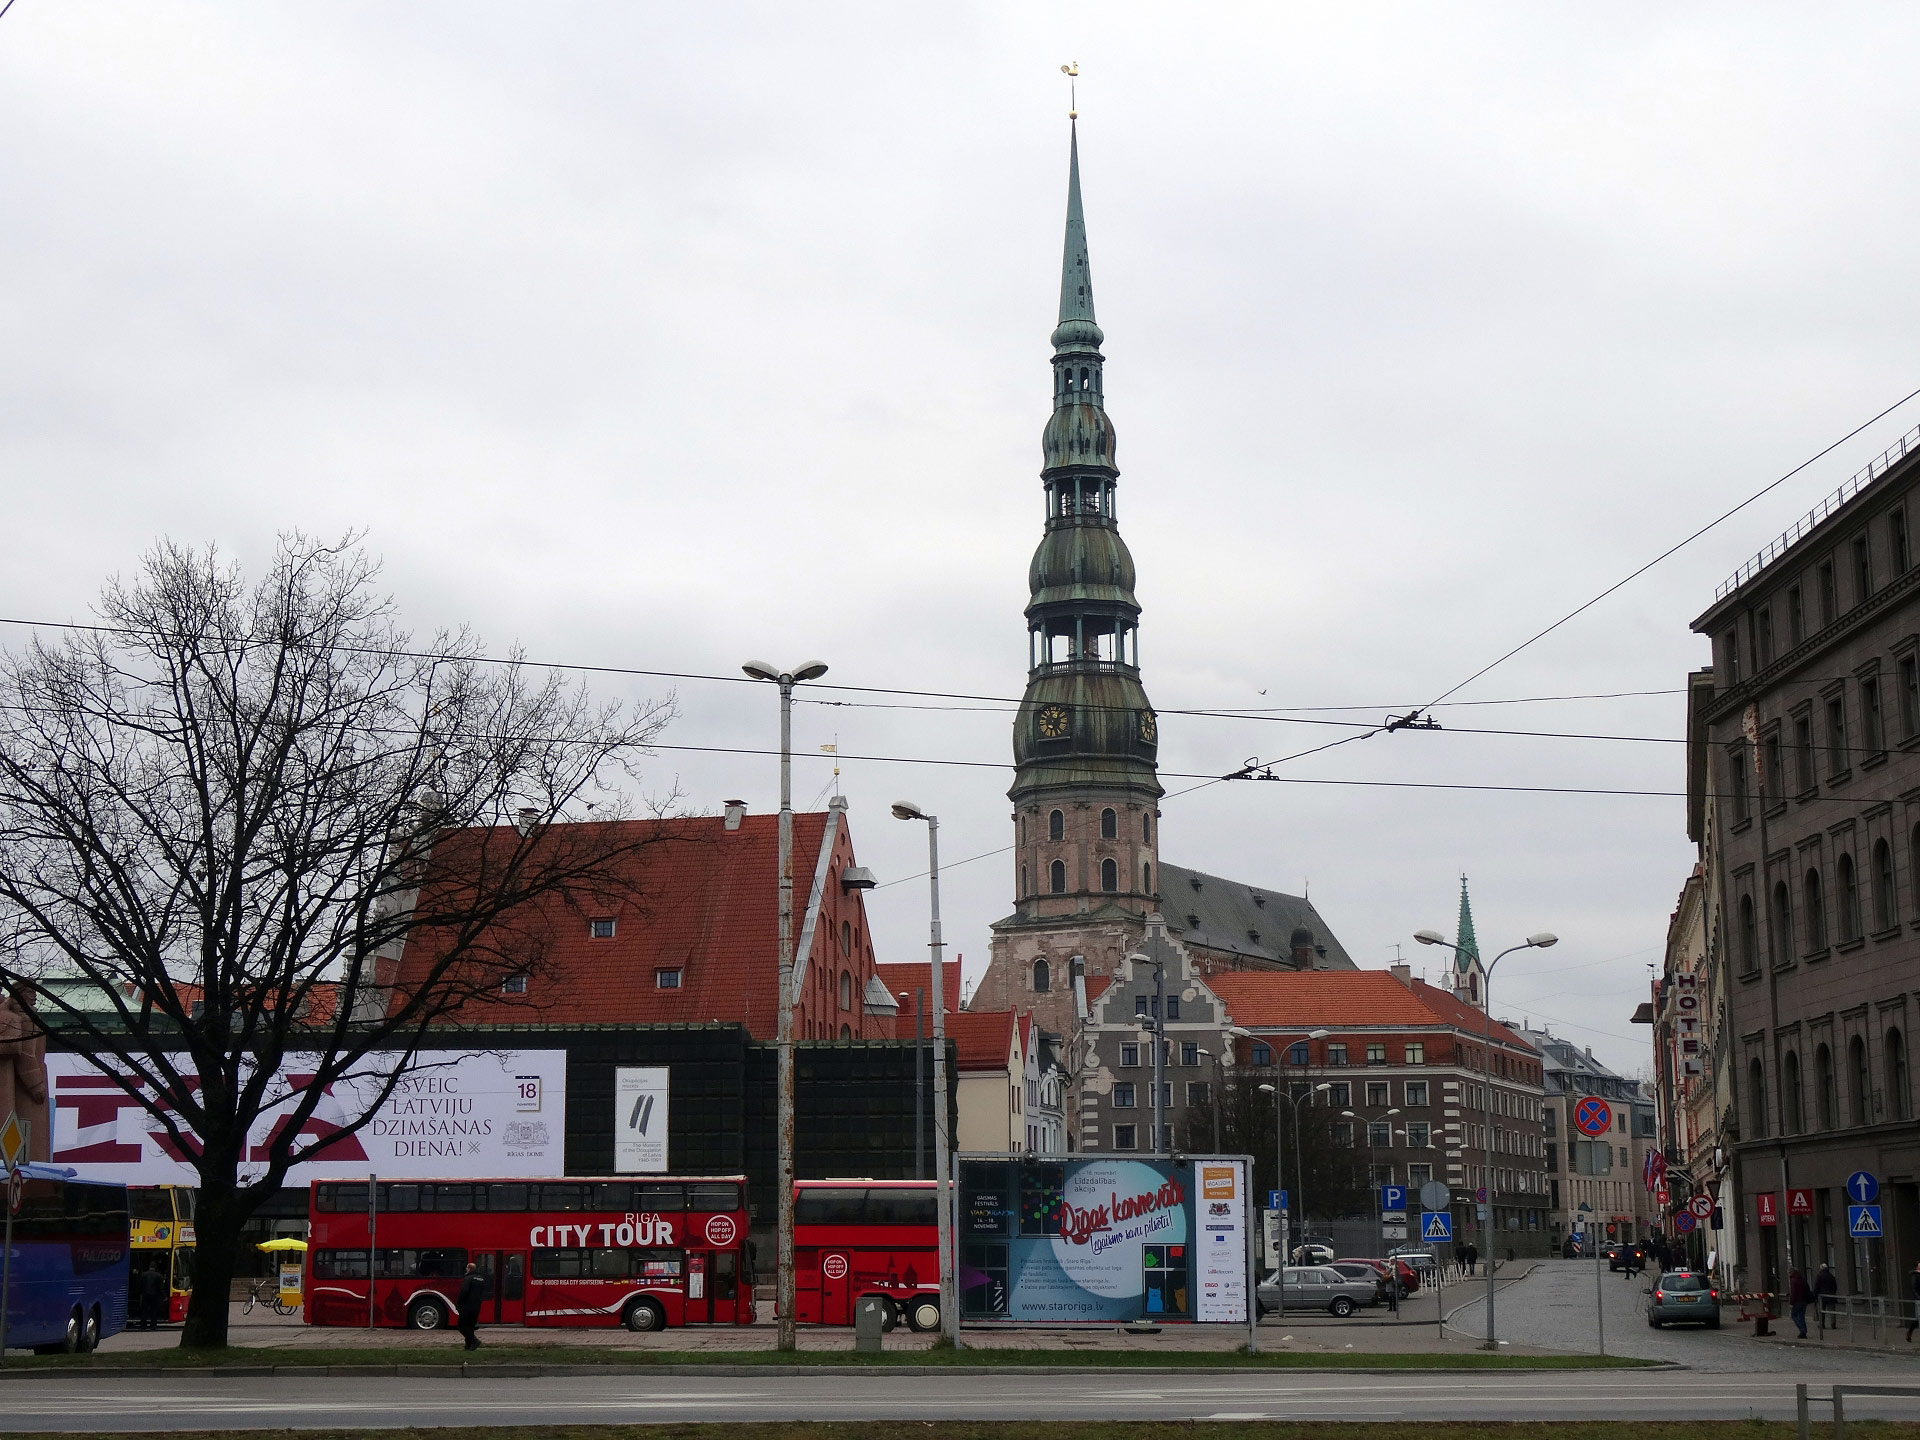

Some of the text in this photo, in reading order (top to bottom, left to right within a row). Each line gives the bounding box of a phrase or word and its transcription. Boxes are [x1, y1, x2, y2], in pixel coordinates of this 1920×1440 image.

[1677, 974, 1700, 1075] HOTEL
[402, 1077, 458, 1094] SVEIC
[517, 1083, 537, 1099] 18
[393, 1098, 473, 1118] LATVIJU
[372, 1116, 492, 1136] DZIMŠANAS
[394, 1137, 463, 1156] DIENĀ!
[1074, 1176, 1117, 1185] Līdzdalības
[1074, 1186, 1096, 1194] akcija
[1387, 1188, 1401, 1207] P
[1273, 1193, 1284, 1207] P
[625, 1212, 661, 1224] RIGA
[530, 1221, 674, 1247] CITY TOUR
[1021, 1301, 1104, 1313] www.staroriga.lv
